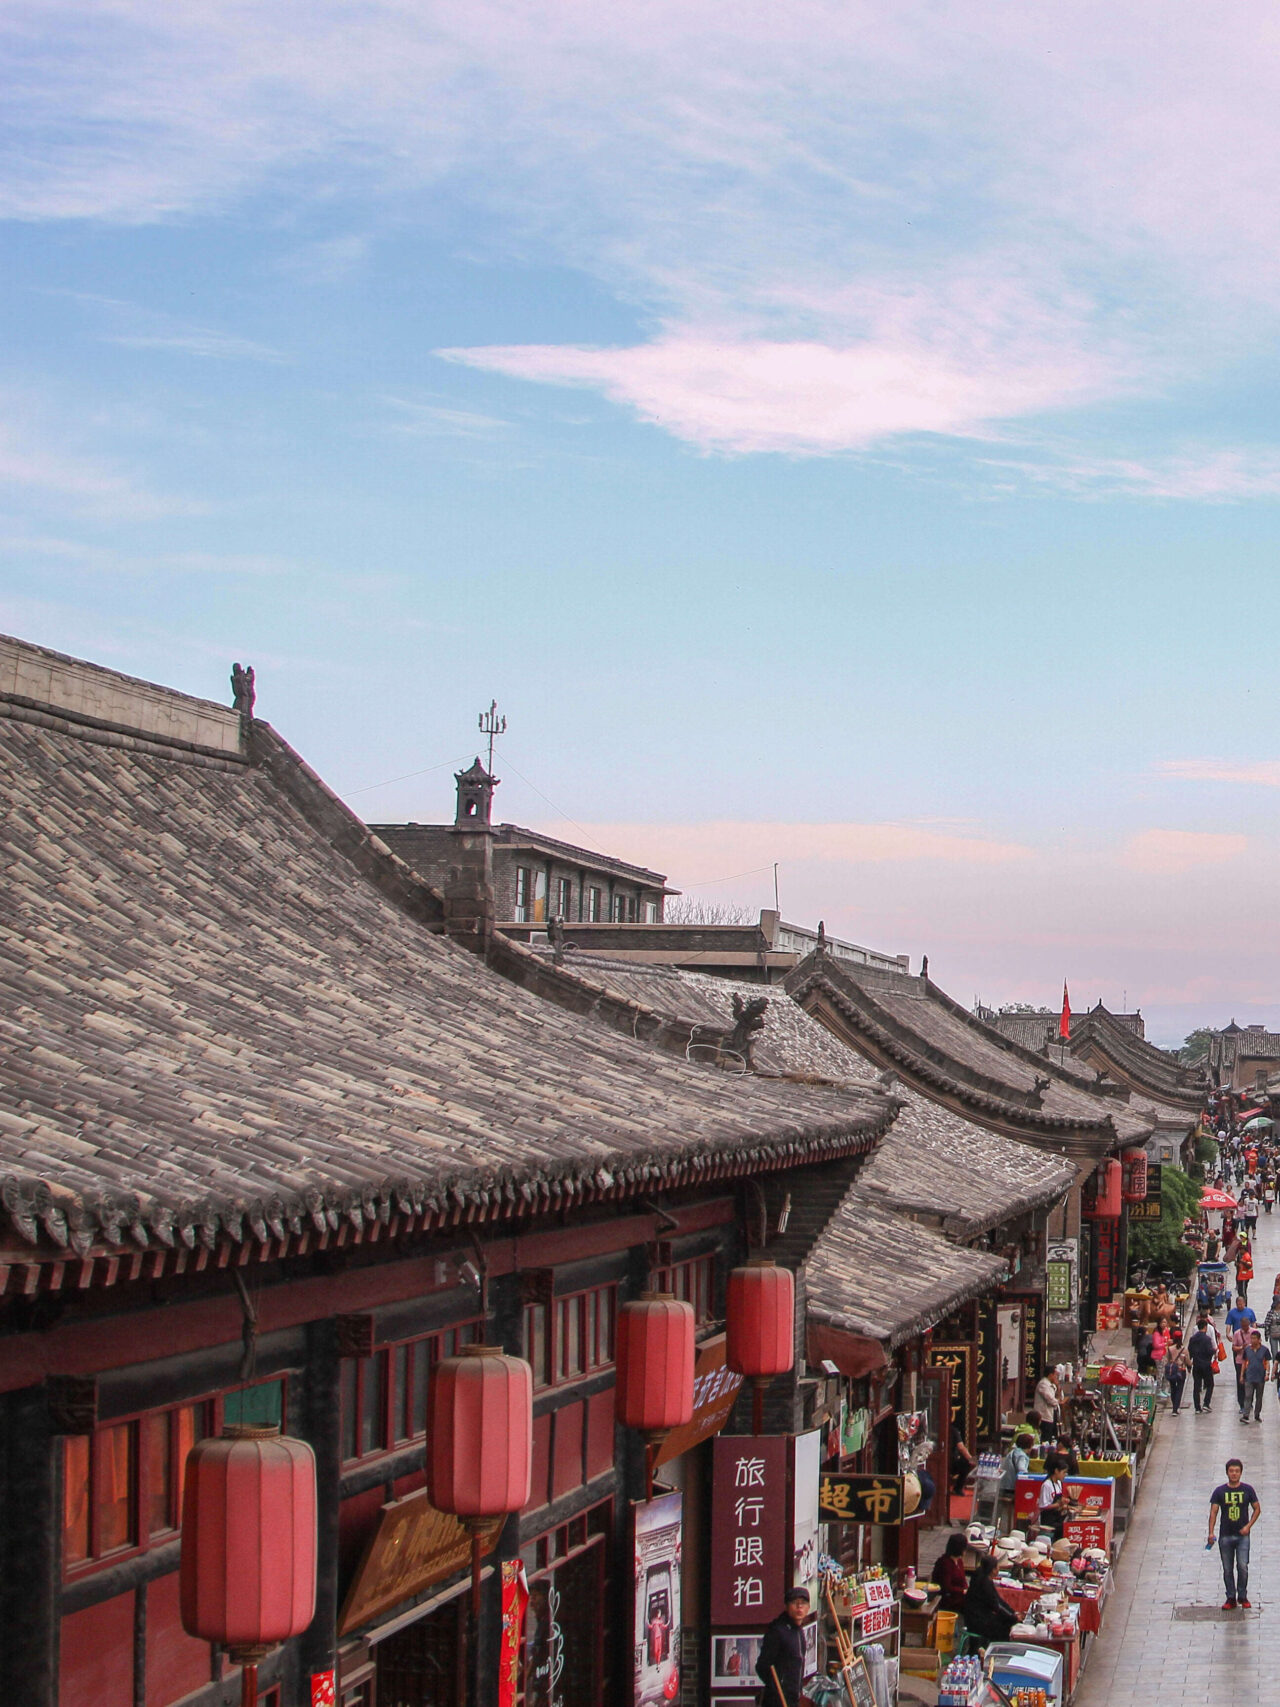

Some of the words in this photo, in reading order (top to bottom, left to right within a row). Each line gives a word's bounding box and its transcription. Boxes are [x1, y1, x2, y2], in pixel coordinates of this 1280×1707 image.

[820, 1478, 897, 1523] 超市
[1224, 1492, 1244, 1503] LET
[734, 1457, 766, 1607] 旅行跟拍
[863, 1607, 892, 1634] 老酸奶
